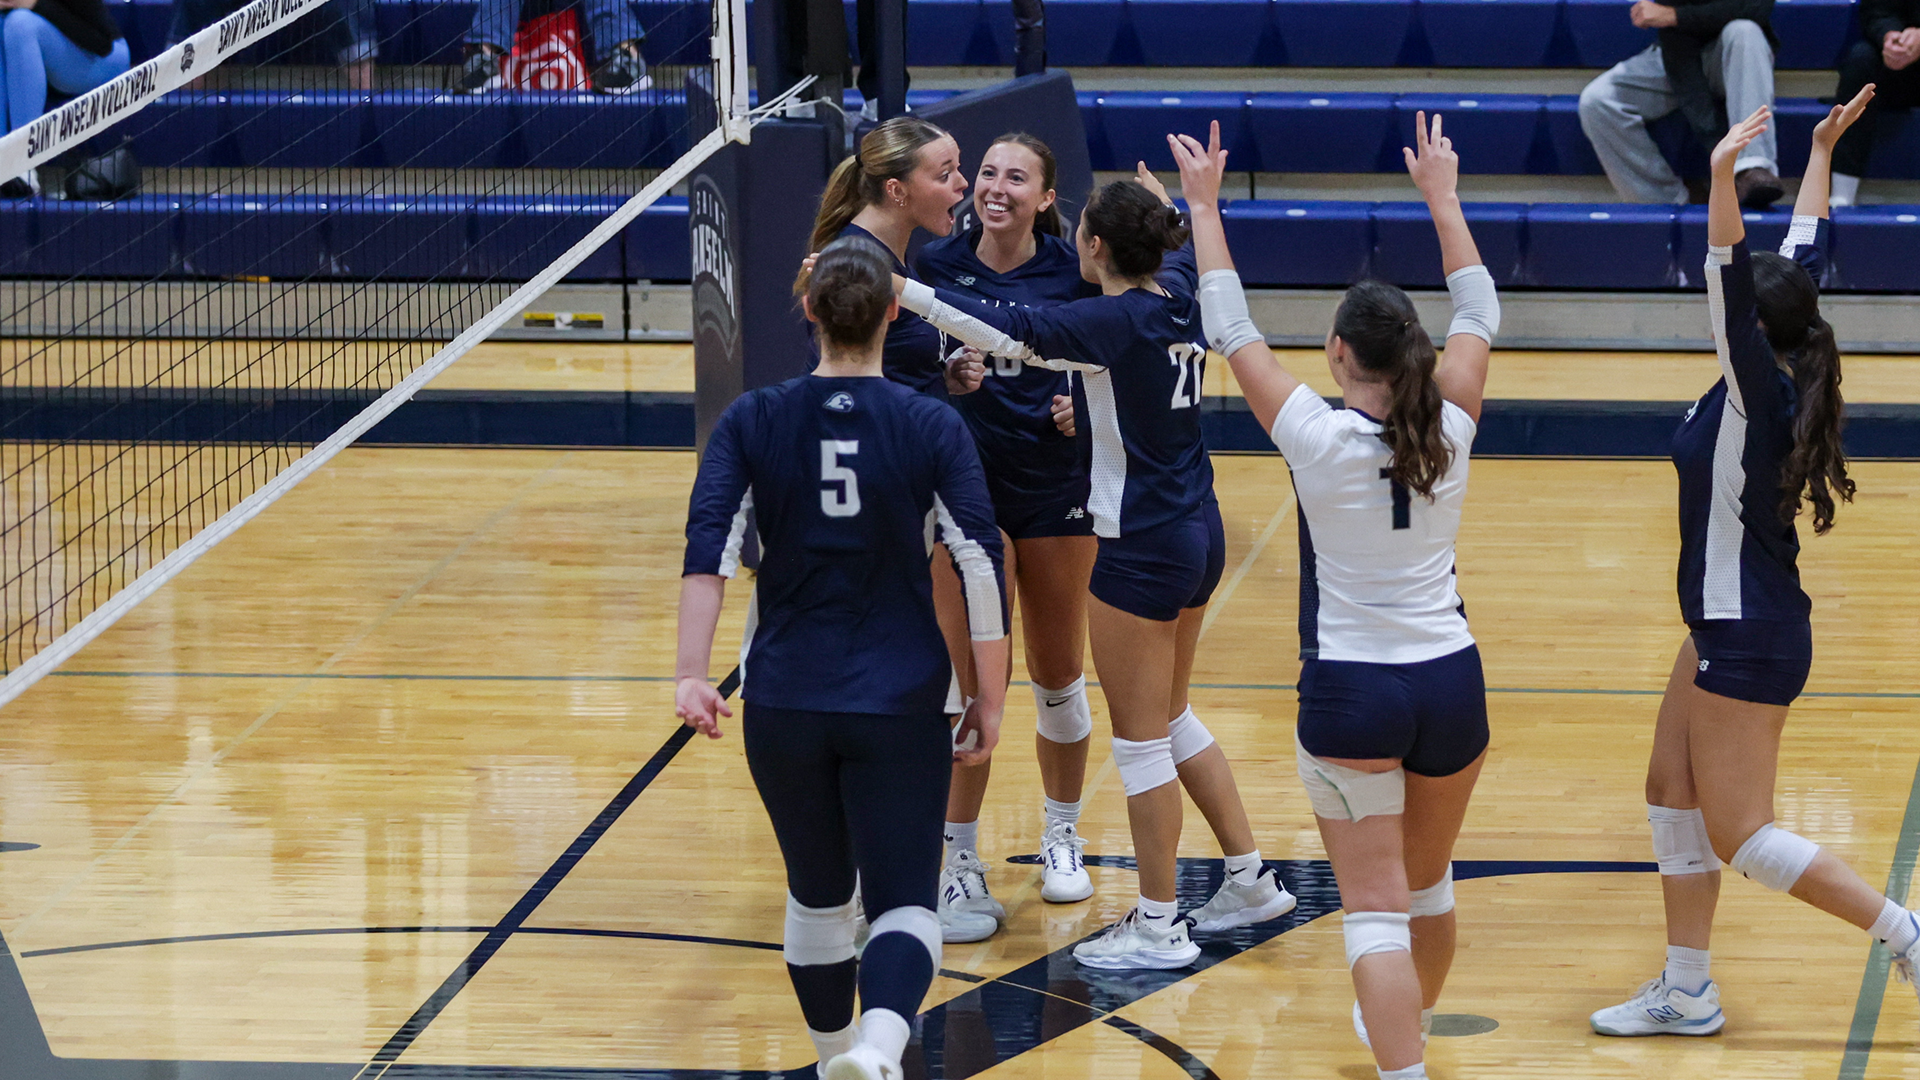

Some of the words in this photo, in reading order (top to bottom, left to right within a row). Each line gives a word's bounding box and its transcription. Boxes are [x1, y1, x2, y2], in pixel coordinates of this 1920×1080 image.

[217, 12, 246, 54] SAINT
[27, 113, 58, 158] SAINT
[60, 92, 100, 142] ANSELM
[102, 61, 158, 119] VOLLEYBALL
[696, 190, 726, 239] SAINT
[692, 224, 736, 319] ANSELM
[1168, 342, 1206, 410] 21
[820, 439, 862, 518] 5
[1379, 467, 1411, 530] 1
